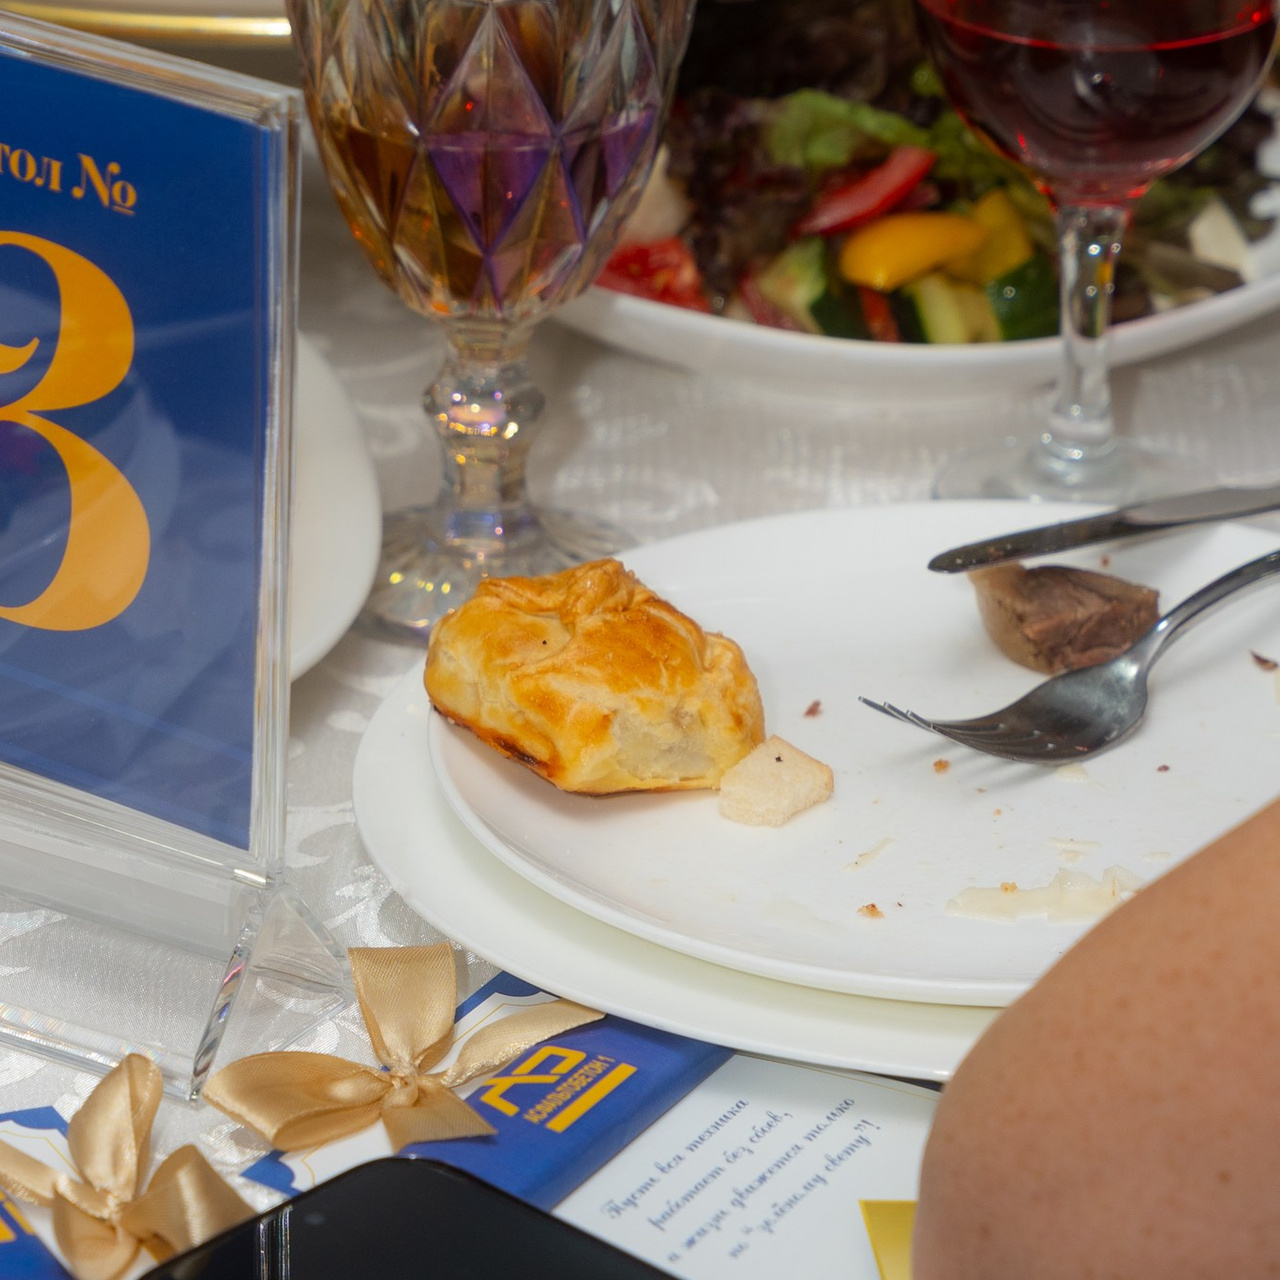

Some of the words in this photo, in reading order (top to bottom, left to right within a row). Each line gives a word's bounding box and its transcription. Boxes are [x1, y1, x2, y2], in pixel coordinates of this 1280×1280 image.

[71, 152, 137, 216] №
[522, 1058, 611, 1125] АСФАЛЬТОБЕТОН
[600, 1176, 661, 1220] Пусть
[654, 1153, 685, 1175] вся
[685, 1098, 750, 1154] техника
[648, 1166, 726, 1232] работает
[724, 1145, 754, 1165] без
[748, 1110, 794, 1144] сбоев,
[730, 1142, 803, 1211] движется
[803, 1097, 856, 1143] только
